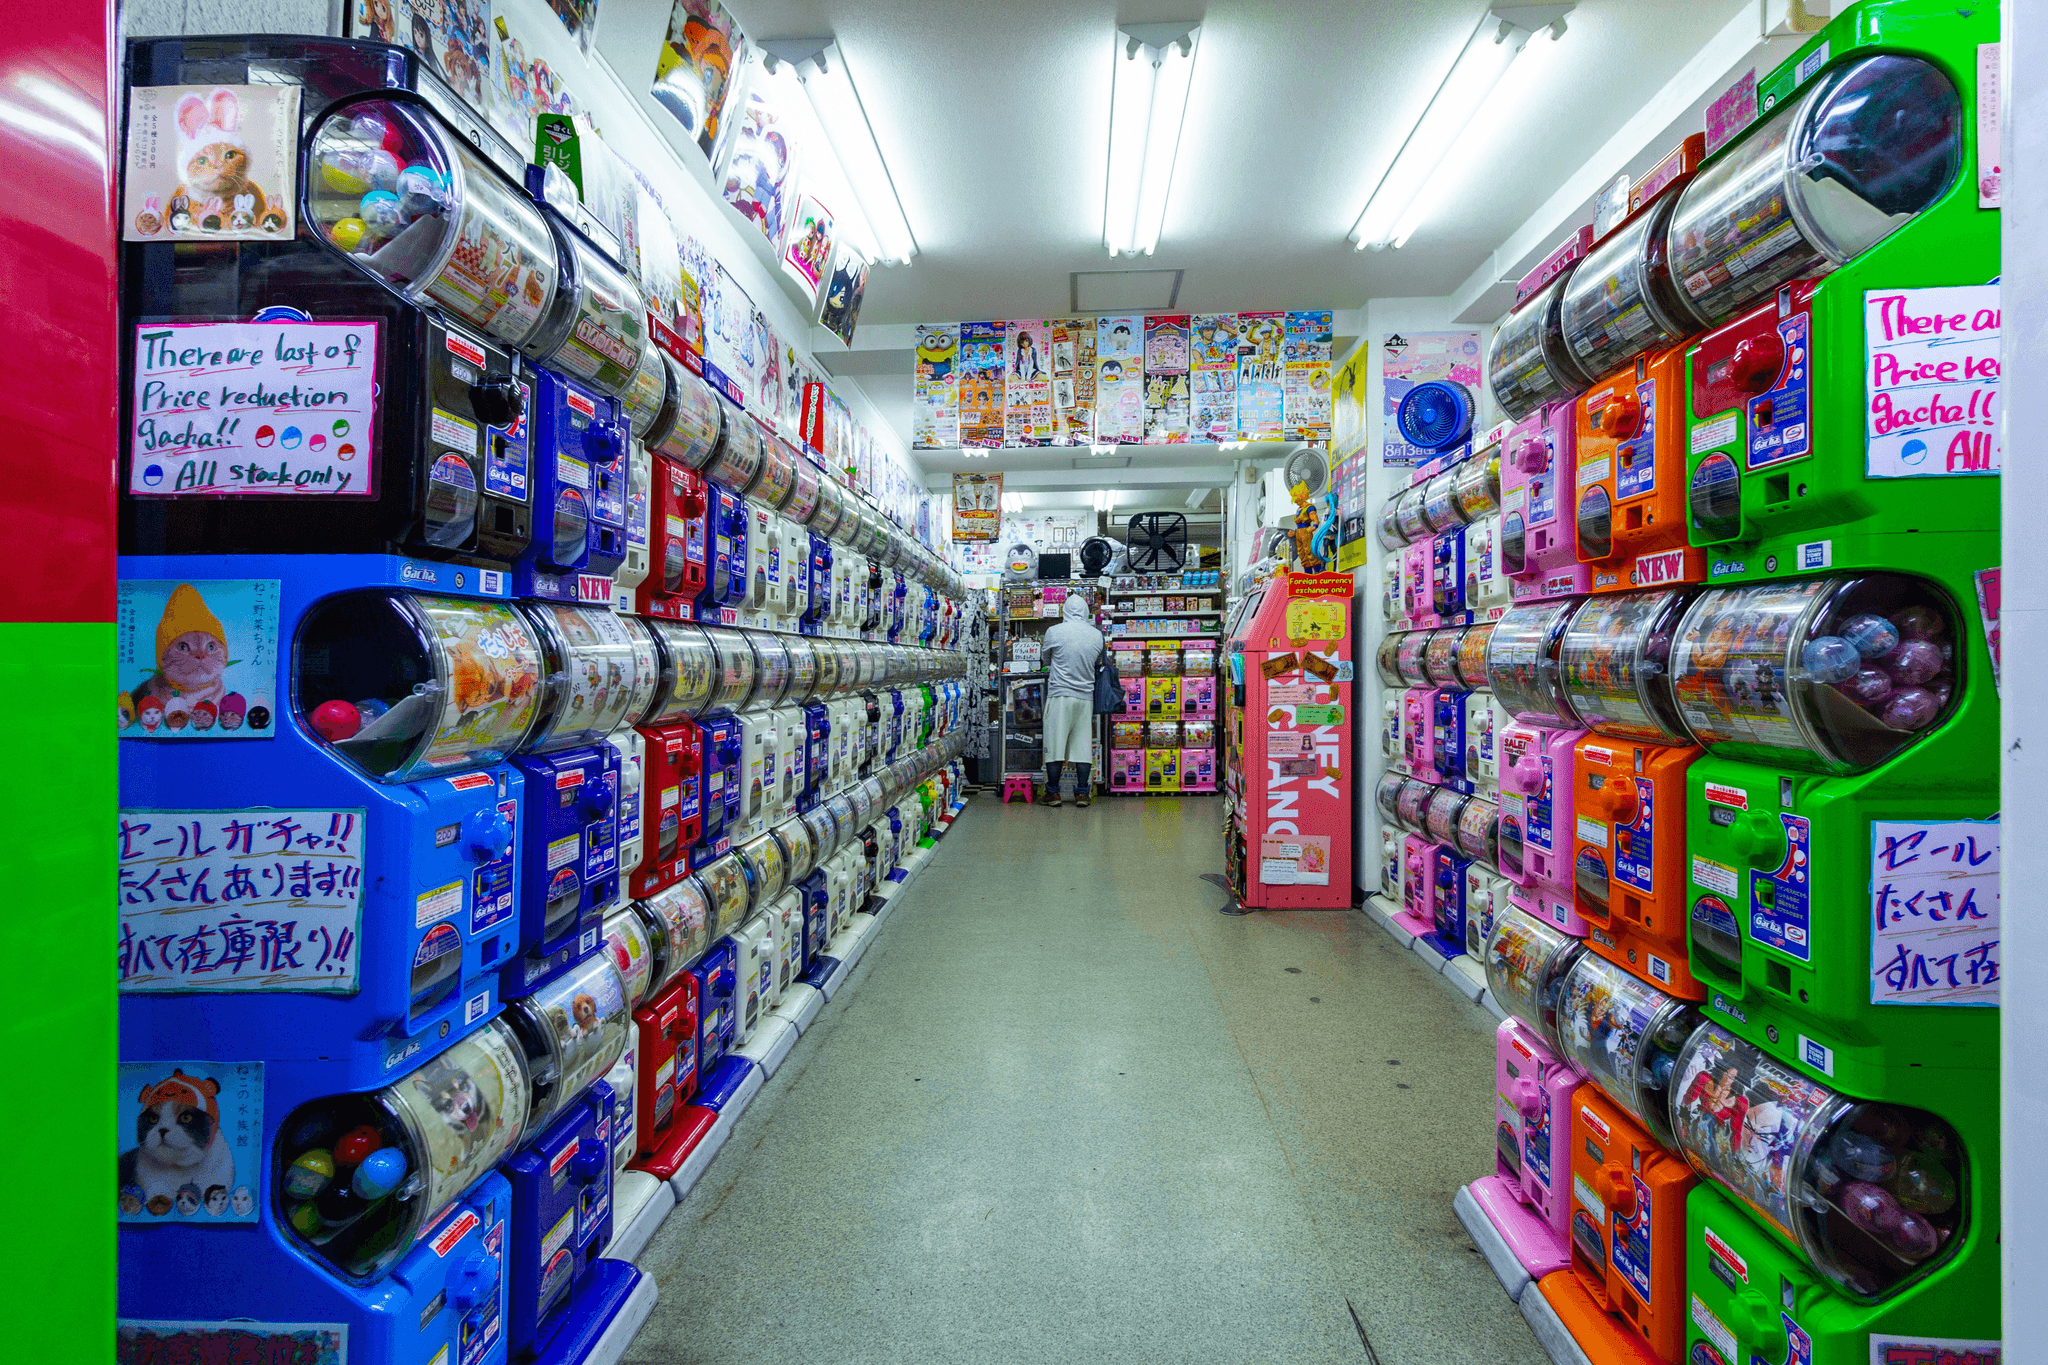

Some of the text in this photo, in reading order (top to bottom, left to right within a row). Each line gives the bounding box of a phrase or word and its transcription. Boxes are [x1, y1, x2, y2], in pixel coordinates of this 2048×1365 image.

[1551, 250, 1576, 276] NEW
[1868, 295, 1968, 341] There
[141, 331, 361, 369] There are last of
[1873, 353, 1958, 387] Price
[143, 381, 210, 411] Price
[1871, 389, 1996, 434] gacha!!
[983, 439, 1002, 448] NEW
[1946, 430, 1992, 472] All
[175, 460, 351, 495] All stock only
[1289, 577, 1352, 587] Foreign currency
[1638, 552, 1682, 585] NEW
[579, 576, 613, 601] NEW
[1331, 586, 1346, 594] only
[251, 582, 266, 666] ねこ野菜ちゃん
[721, 608, 738, 624] NEW
[1504, 738, 1526, 750] SALE!
[436, 829, 452, 842] 200
[1878, 830, 2000, 871] セール
[1876, 884, 2000, 931] たくさん
[236, 1062, 250, 1148] ねこの水族館
